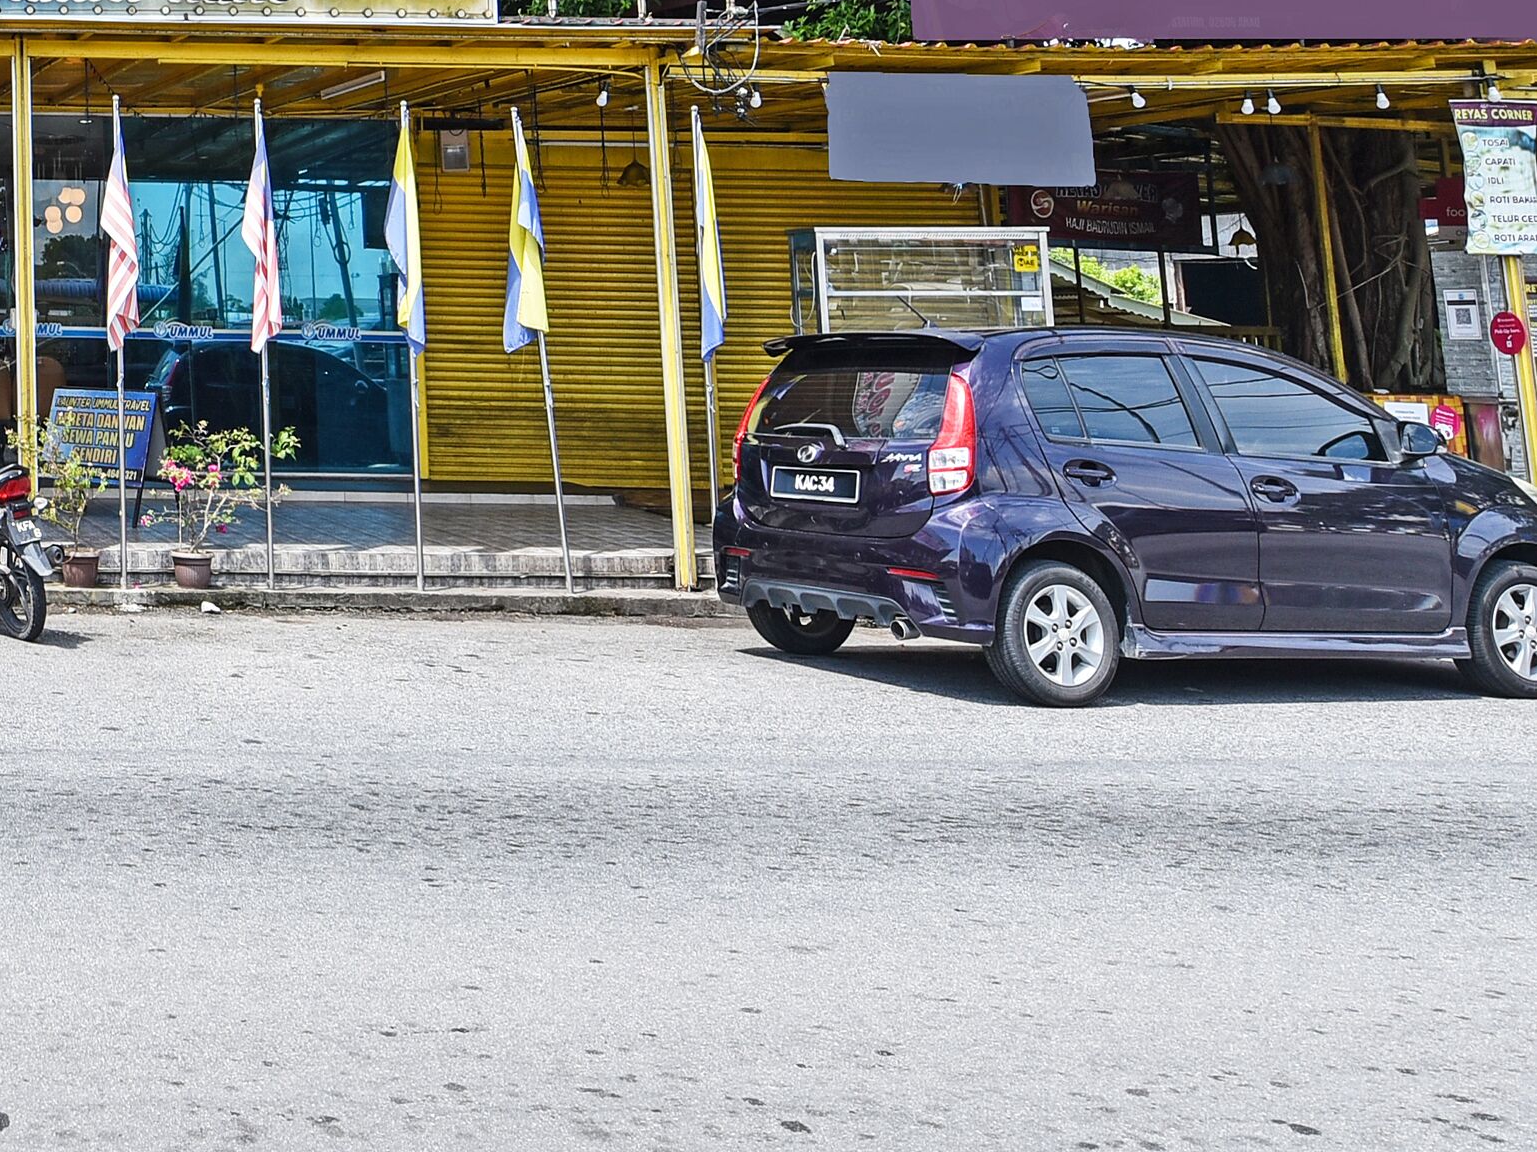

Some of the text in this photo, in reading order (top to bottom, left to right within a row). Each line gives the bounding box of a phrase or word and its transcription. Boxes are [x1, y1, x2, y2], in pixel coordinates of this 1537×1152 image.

[1454, 108, 1533, 121] REYAS CORNER
[1482, 139, 1509, 147] TOSAI
[1485, 158, 1516, 166] CAPATI
[1487, 177, 1504, 185] IDLI
[1490, 196, 1510, 204] ROTI
[1491, 215, 1519, 223] TELUR
[1065, 217, 1085, 230] HAJI
[1494, 234, 1516, 242] ROTI
[169, 325, 214, 339] UMMUL
[316, 326, 362, 340] UMMUL
[95, 431, 134, 448] PANU
